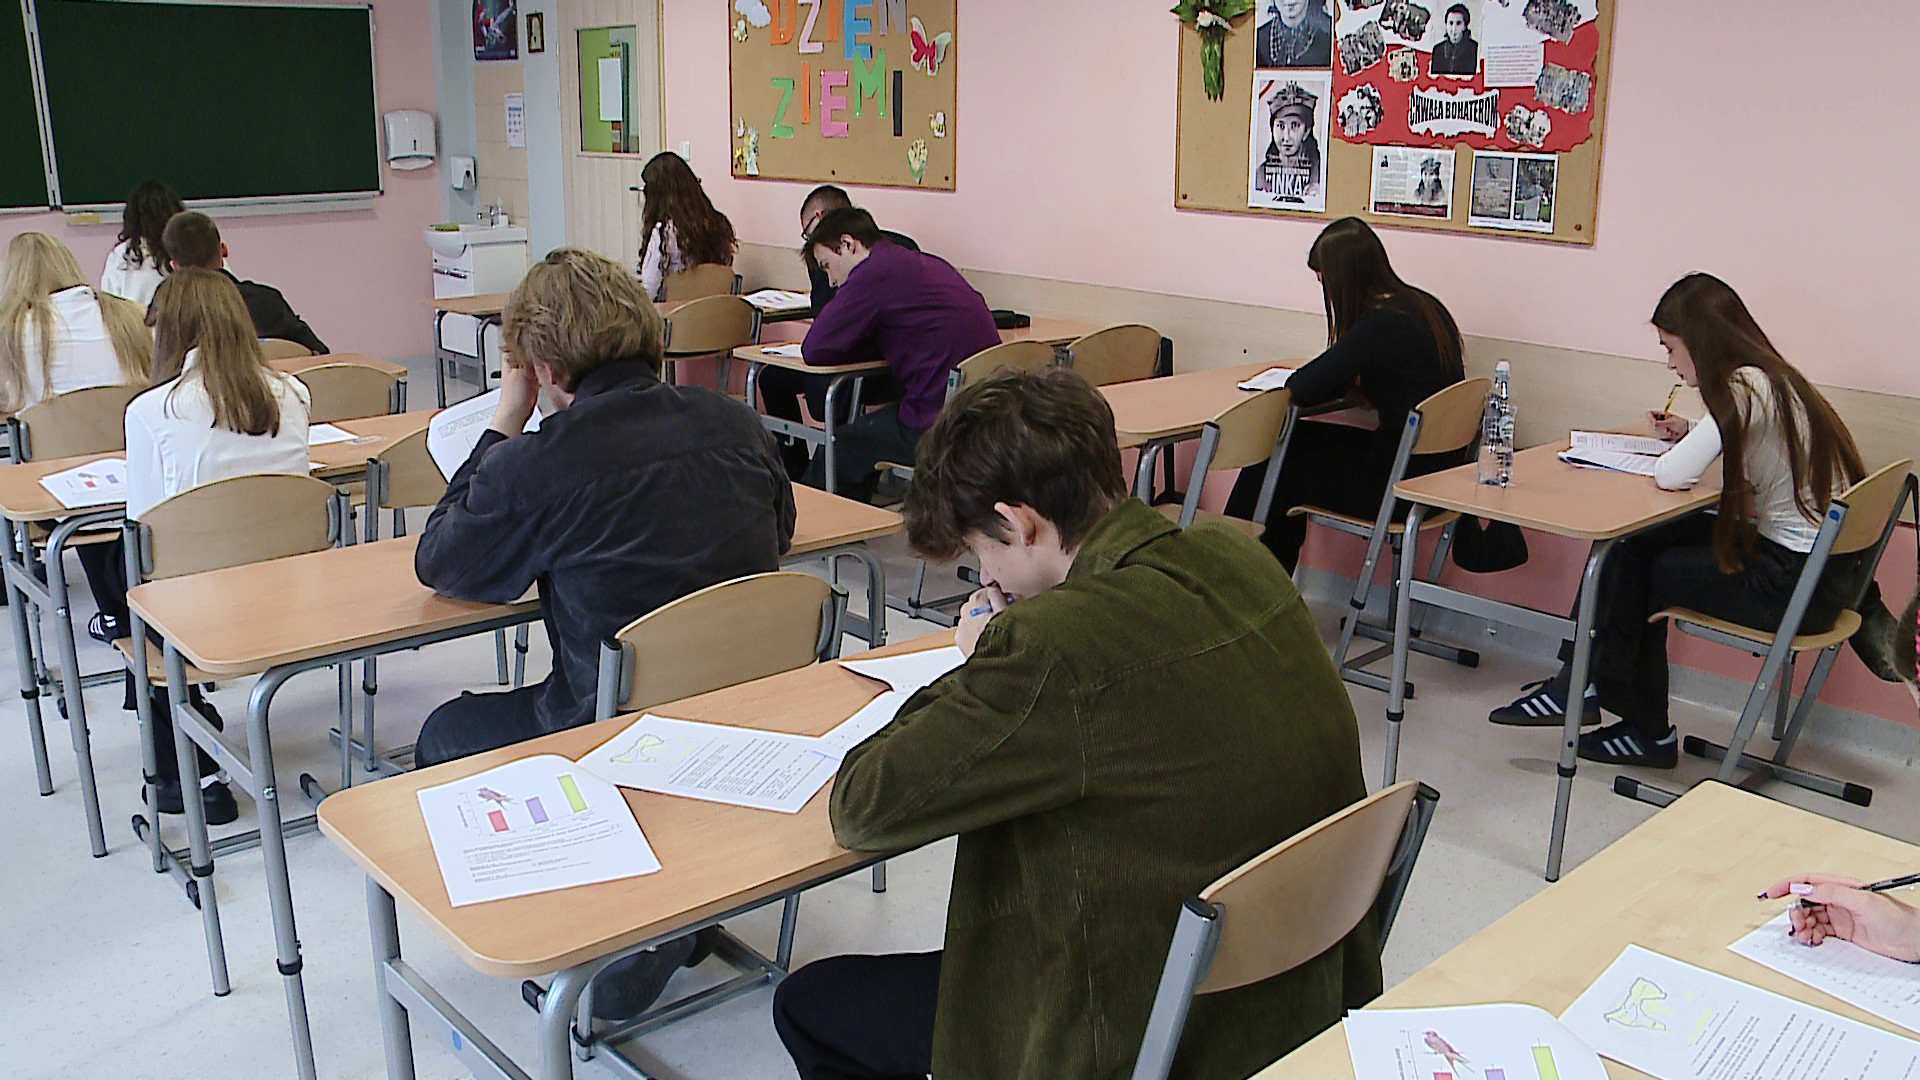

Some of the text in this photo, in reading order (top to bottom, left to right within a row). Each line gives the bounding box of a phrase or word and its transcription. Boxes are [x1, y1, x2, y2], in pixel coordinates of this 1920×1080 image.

[770, 48, 903, 139] ZIEMI
[1410, 92, 1498, 130] CHWAŁA BOHATEROM
